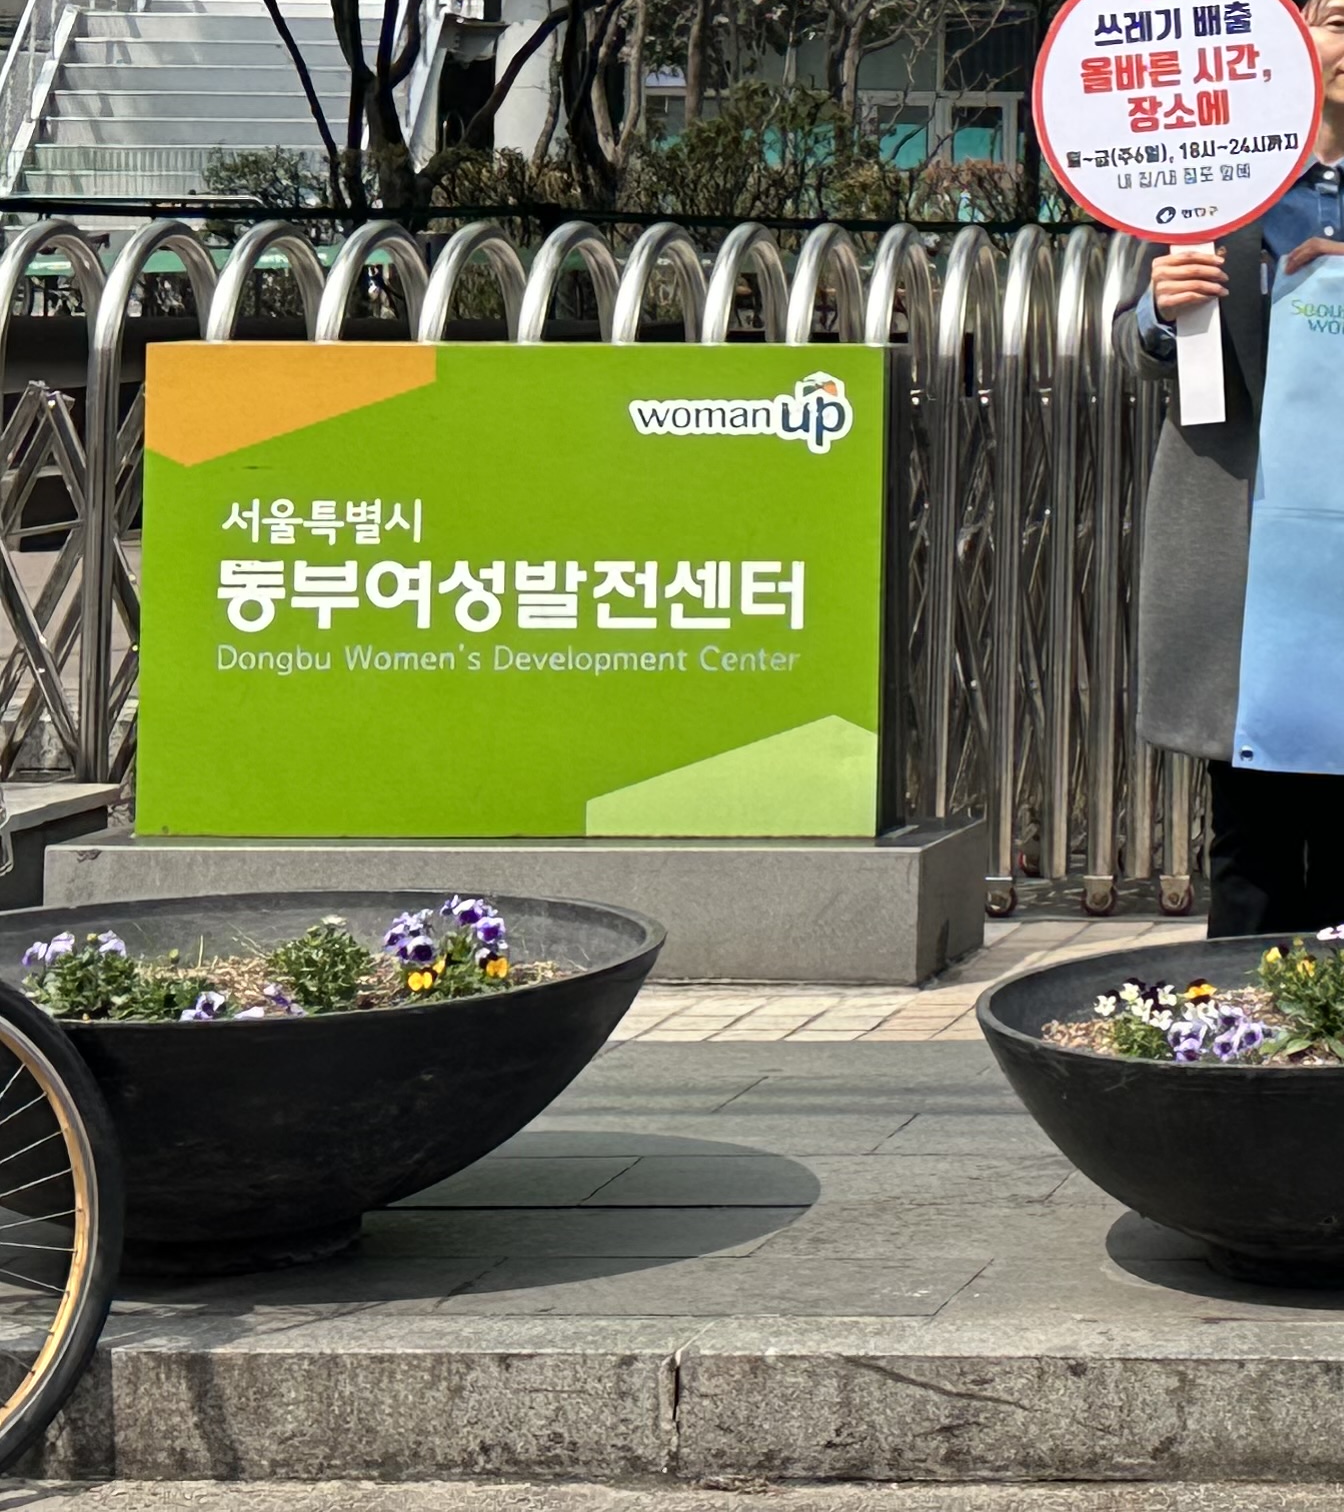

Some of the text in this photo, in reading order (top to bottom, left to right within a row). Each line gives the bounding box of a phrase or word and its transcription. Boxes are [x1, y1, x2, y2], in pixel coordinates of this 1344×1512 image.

[1094, 1, 1252, 47] 쓰레기 배출
[1080, 43, 1272, 94] 올바른 시간,
[1127, 89, 1231, 134] 장소에
[637, 394, 846, 445] woman up
[221, 498, 423, 545] 서울특별시
[216, 560, 805, 632] 동부여성발전센터
[217, 643, 801, 676] Dongbu Women's Development Center
